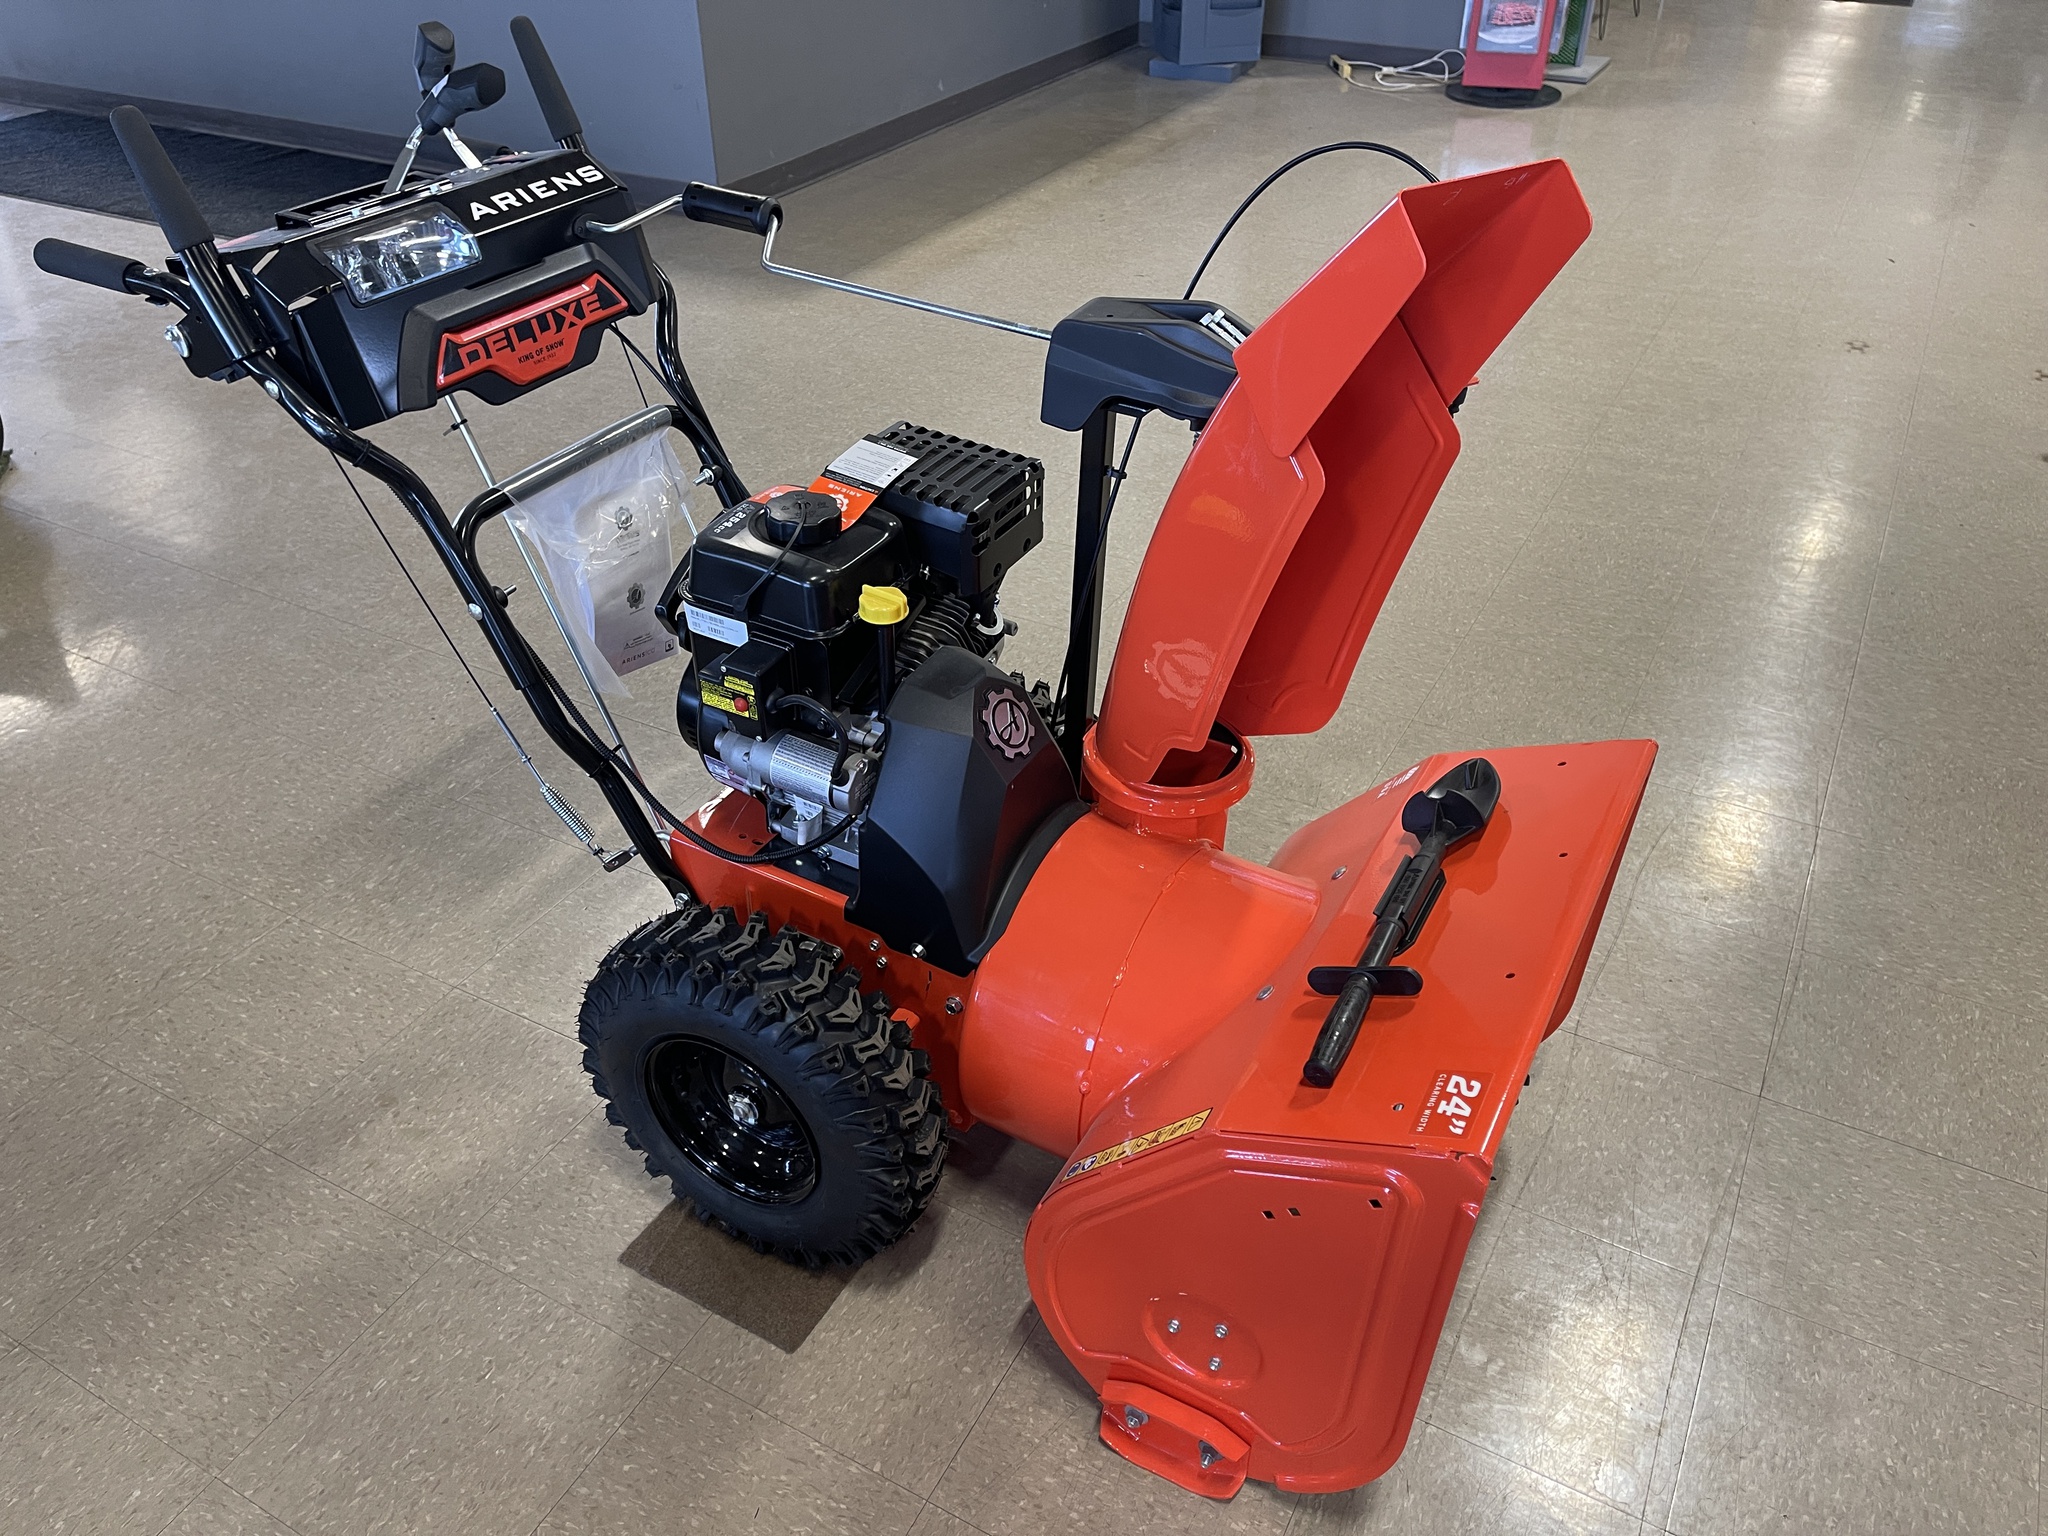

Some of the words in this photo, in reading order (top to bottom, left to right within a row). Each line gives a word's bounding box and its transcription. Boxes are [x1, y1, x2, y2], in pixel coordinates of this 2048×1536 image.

[469, 165, 604, 221] ARIENS
[457, 293, 603, 369] DELUXE
[517, 352, 534, 365] KING
[535, 347, 544, 356] OF
[545, 339, 564, 353] SNOW
[827, 483, 863, 498] ARIENS
[1427, 1073, 1448, 1107] CLEARING
[1416, 1109, 1432, 1132] WIDTH
